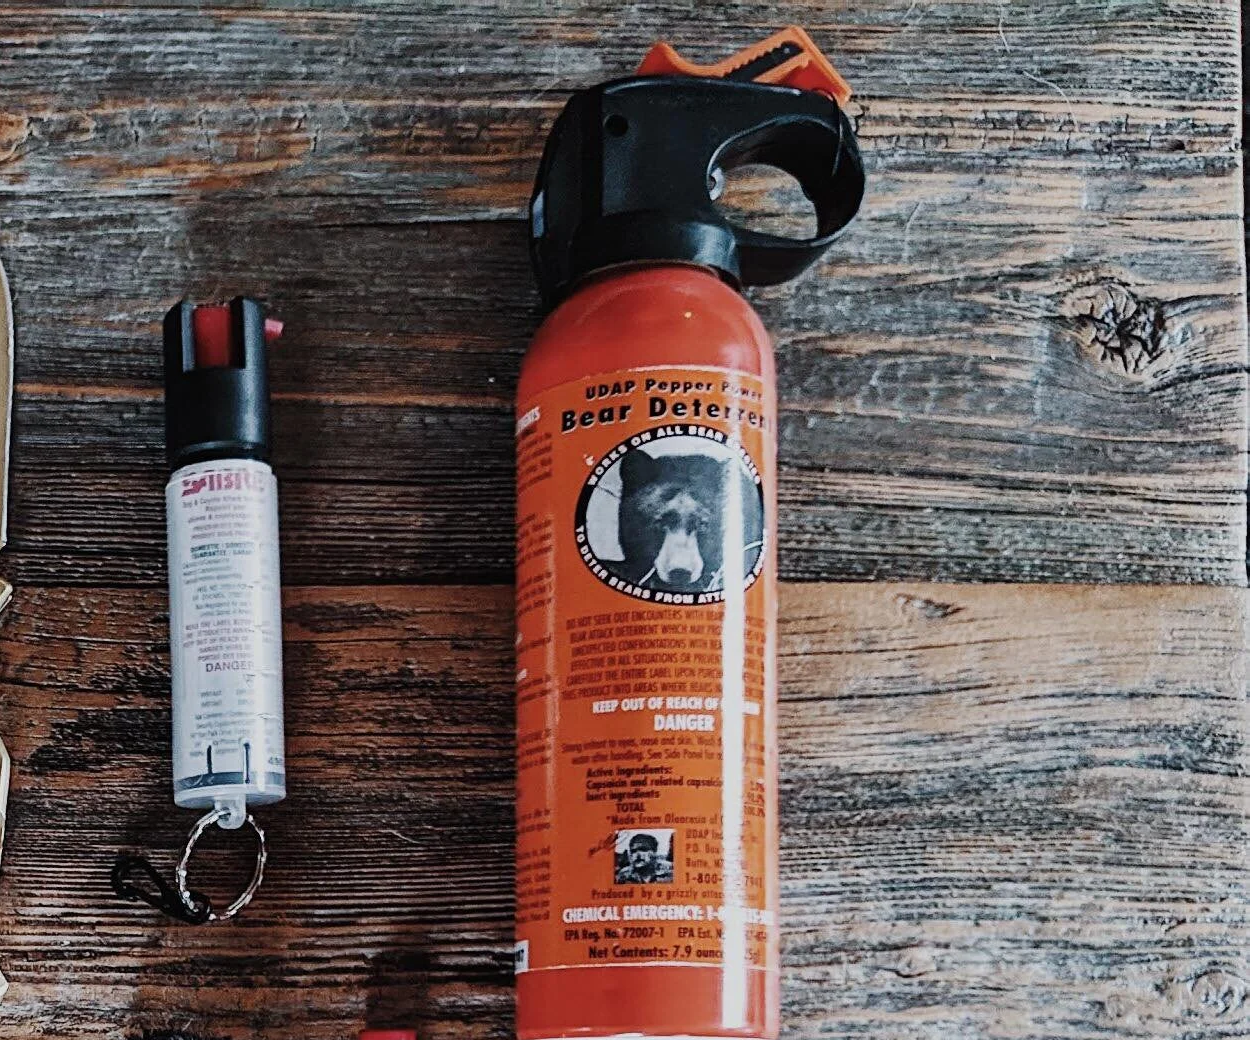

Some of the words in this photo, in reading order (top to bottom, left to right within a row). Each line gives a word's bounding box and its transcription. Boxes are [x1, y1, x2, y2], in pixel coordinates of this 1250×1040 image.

[585, 381, 636, 401] UDAP
[645, 379, 712, 396] Pepper
[561, 404, 631, 435] Bear
[657, 425, 684, 438] ALL
[688, 425, 723, 442] BEAR
[609, 577, 651, 599] BEARS
[654, 592, 694, 604] FROM
[592, 700, 619, 713] KEEP
[621, 698, 645, 711] OUT
[648, 697, 664, 710] OF
[666, 697, 703, 709] REACH
[705, 697, 719, 710] OF
[654, 714, 715, 732] DANGER
[586, 768, 613, 778] Active
[586, 779, 627, 792] Capsaicin
[630, 776, 648, 787] and
[650, 776, 683, 787] related
[609, 788, 661, 802] ingredients
[616, 802, 645, 814] TOTAL
[638, 813, 661, 824] from
[591, 887, 634, 899] Produced
[641, 887, 652, 900] by
[666, 888, 698, 901] grizzly
[562, 906, 621, 924] CHEMICAL
[564, 929, 580, 941] EPA
[581, 928, 600, 942] Reg.
[604, 928, 620, 939] No.
[623, 927, 665, 938] 72007-1
[678, 927, 694, 938] EPA
[588, 945, 608, 958] Net
[611, 944, 668, 958] Contents:
[672, 945, 692, 958] 7.9
[696, 949, 723, 959] ounc
